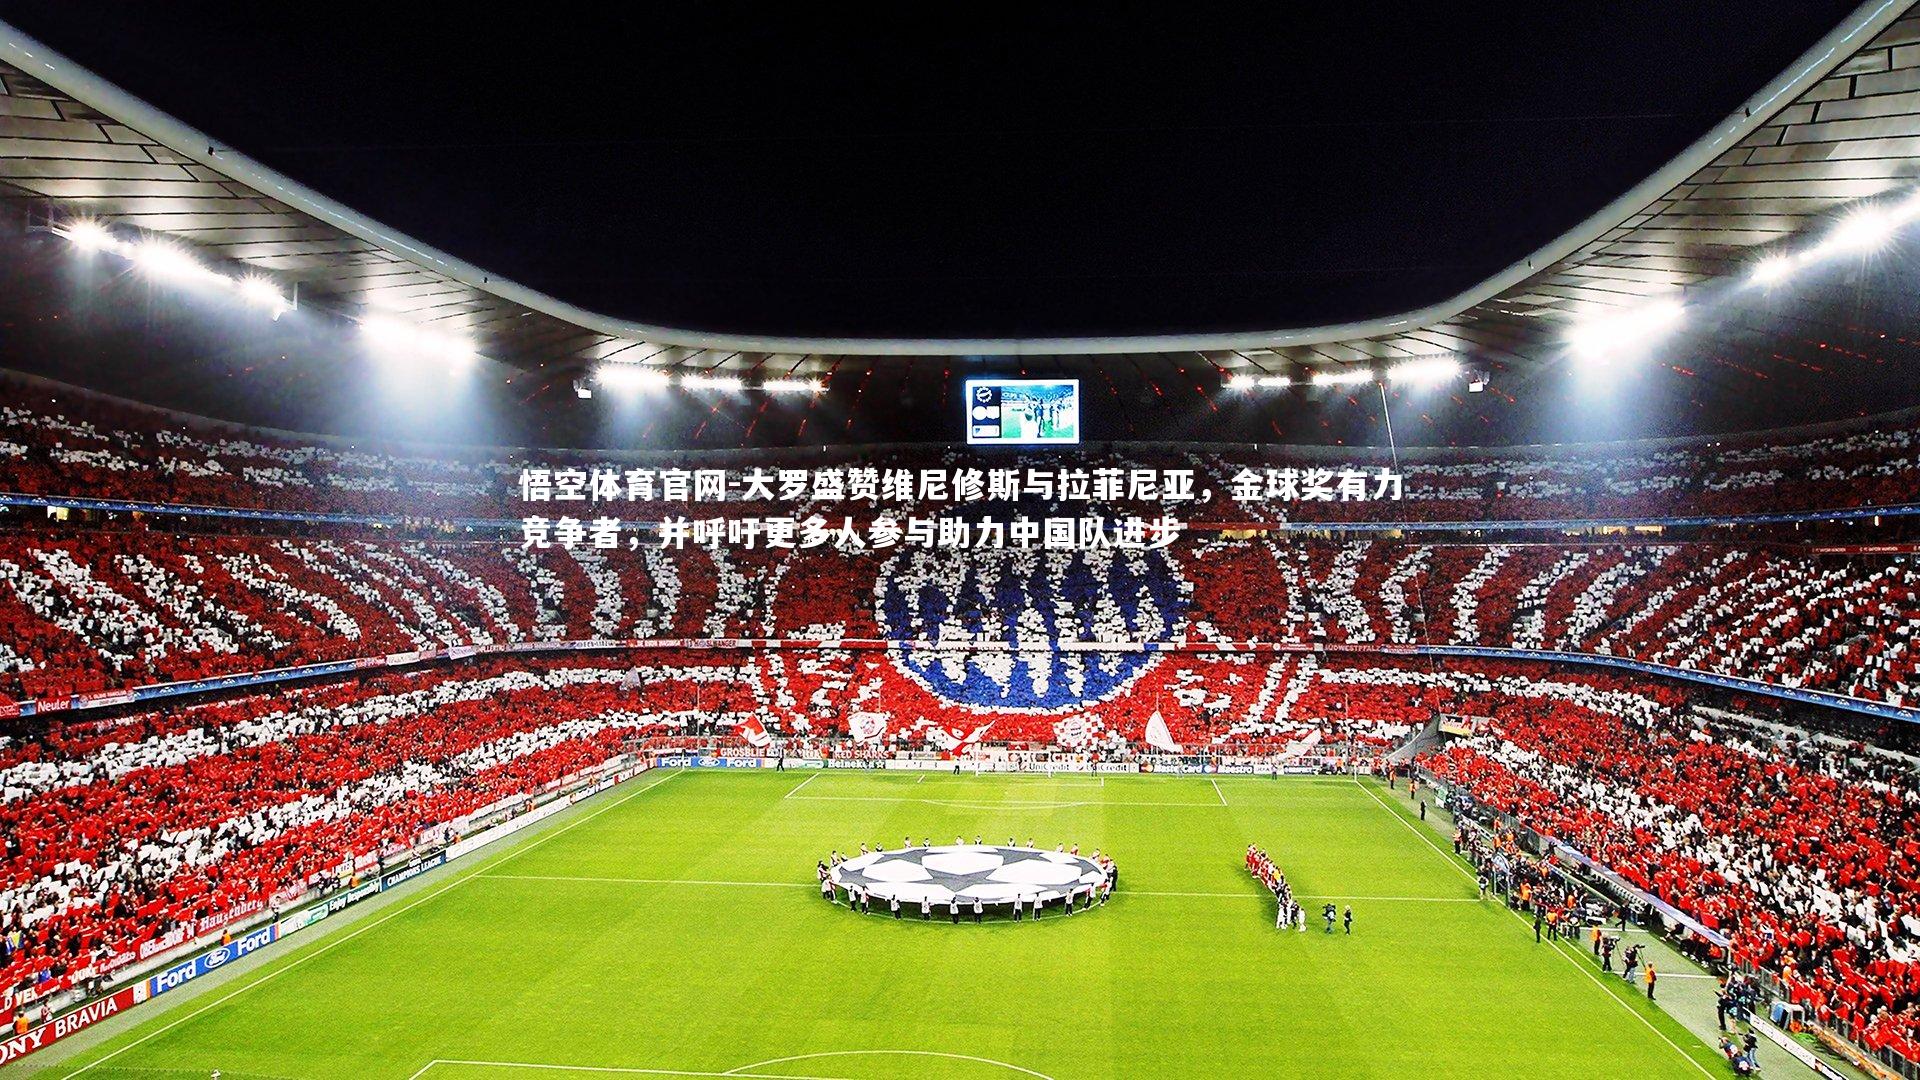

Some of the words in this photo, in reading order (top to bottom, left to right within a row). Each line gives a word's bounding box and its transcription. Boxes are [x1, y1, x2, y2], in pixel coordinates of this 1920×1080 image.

[37, 698, 71, 713] Neuler
[661, 757, 692, 767] Ford
[726, 757, 757, 768] Ford
[386, 864, 421, 886] CHAMPIONS
[421, 855, 442, 874] LEAGUE
[329, 895, 347, 911] Enjoy
[236, 927, 271, 956] Ford
[156, 959, 197, 992] Ford
[55, 997, 118, 1039] BRAVIA
